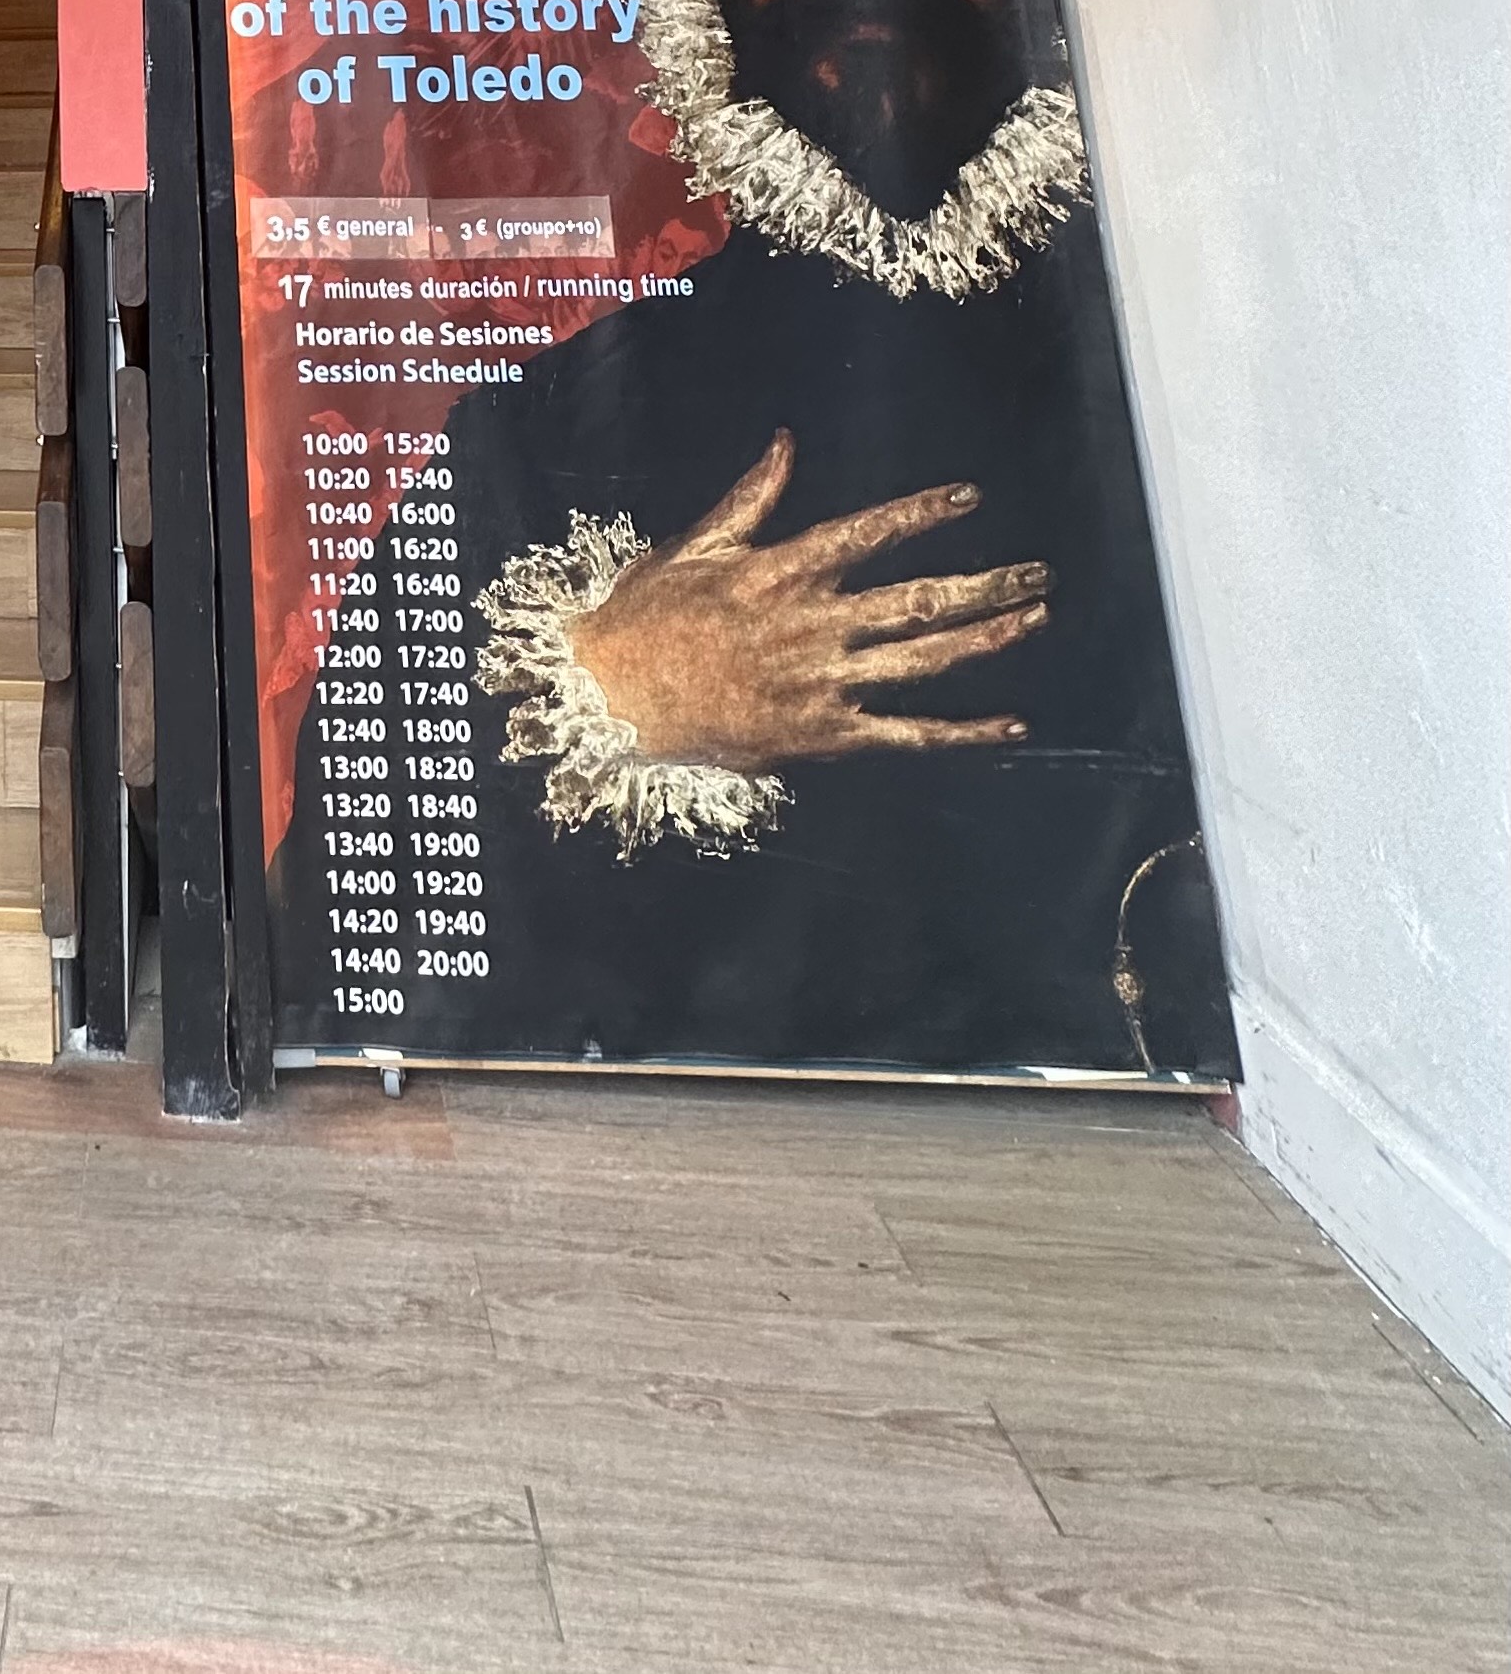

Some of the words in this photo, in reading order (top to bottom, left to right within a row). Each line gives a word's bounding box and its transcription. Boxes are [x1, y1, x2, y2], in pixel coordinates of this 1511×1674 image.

[298, 55, 356, 104] of
[378, 53, 583, 102] Toledo
[266, 215, 310, 242] 3,5
[317, 215, 331, 236] €
[336, 216, 414, 240] general
[460, 223, 472, 240] 3
[476, 218, 488, 235] €
[277, 274, 313, 308] 17
[324, 277, 413, 299] minutes
[420, 275, 517, 299] duración
[523, 275, 530, 297] /
[537, 273, 634, 303] running
[640, 273, 695, 296] time
[295, 321, 394, 346] Horario
[400, 322, 434, 346] de
[438, 321, 554, 346] Sesiones
[297, 358, 395, 384] Session
[403, 357, 524, 383] Schedule
[302, 432, 368, 455] 10:00
[383, 432, 450, 455] 15:20
[304, 467, 370, 490] 10:20
[385, 467, 453, 490] 15:40
[306, 502, 372, 525] 10:40
[388, 502, 456, 525] 16:00
[308, 537, 375, 560] 11:00
[390, 537, 458, 561] 16:20
[310, 573, 377, 596] 11:20
[392, 573, 461, 597] 16:40
[311, 609, 379, 632] 11:40
[395, 609, 463, 633] 17:00
[313, 645, 382, 669] 12:00
[397, 646, 466, 669] 17:20
[315, 682, 384, 705] 12:20
[400, 682, 469, 706] 17:40
[318, 718, 386, 742] 12:40
[402, 718, 471, 743] 18:00
[320, 756, 388, 780] 13:00
[405, 756, 475, 781] 18:20
[322, 793, 391, 818] 13:20
[407, 794, 478, 819] 18:40
[324, 831, 394, 857] 13:40
[410, 832, 480, 858] 19:00
[326, 870, 396, 895] 14:00
[412, 870, 483, 897] 19:20
[328, 908, 398, 934] 14:20
[415, 909, 486, 936] 19:40
[330, 947, 401, 974] 14:40
[417, 949, 489, 976] 20:00
[333, 987, 404, 1015] 15:00
